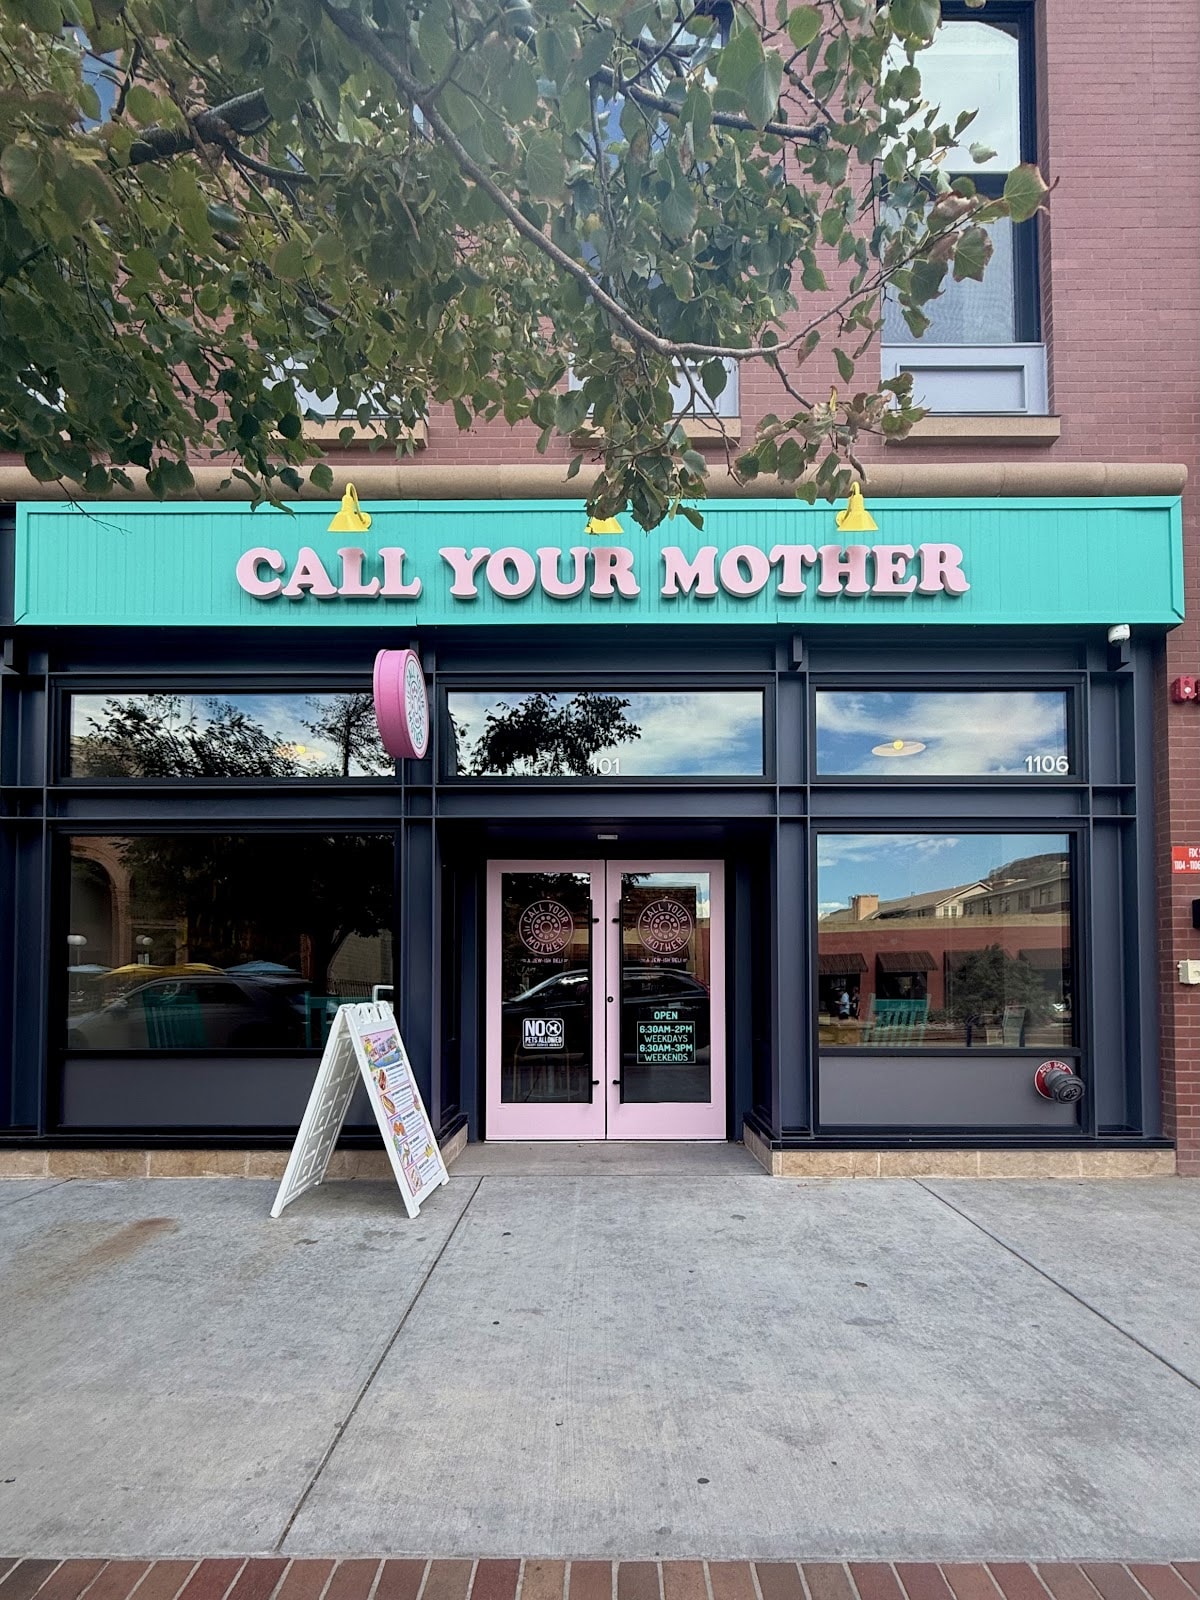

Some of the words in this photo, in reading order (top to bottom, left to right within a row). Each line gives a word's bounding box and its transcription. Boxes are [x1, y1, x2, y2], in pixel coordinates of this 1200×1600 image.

[236, 547, 422, 599] CALL
[439, 547, 641, 599] YOUR
[661, 543, 971, 598] MOTHER
[1025, 755, 1069, 773] 1106
[523, 903, 545, 923] CALL
[548, 903, 569, 924] YOUR
[642, 903, 664, 923] CALL
[667, 902, 688, 923] YOUR
[526, 936, 565, 952] MOTHER
[645, 936, 684, 952] MOTHER
[654, 1011, 678, 1020] OPEN
[525, 1020, 546, 1037] NO
[640, 1025, 693, 1033] 6:30AM-2PM
[525, 1036, 538, 1044] PETS
[539, 1036, 562, 1044] ALLOWED
[644, 1034, 688, 1043] WEEKDAYS
[640, 1044, 693, 1052] 6:30AM-3PM
[644, 1053, 688, 1061] WEEKENDS
